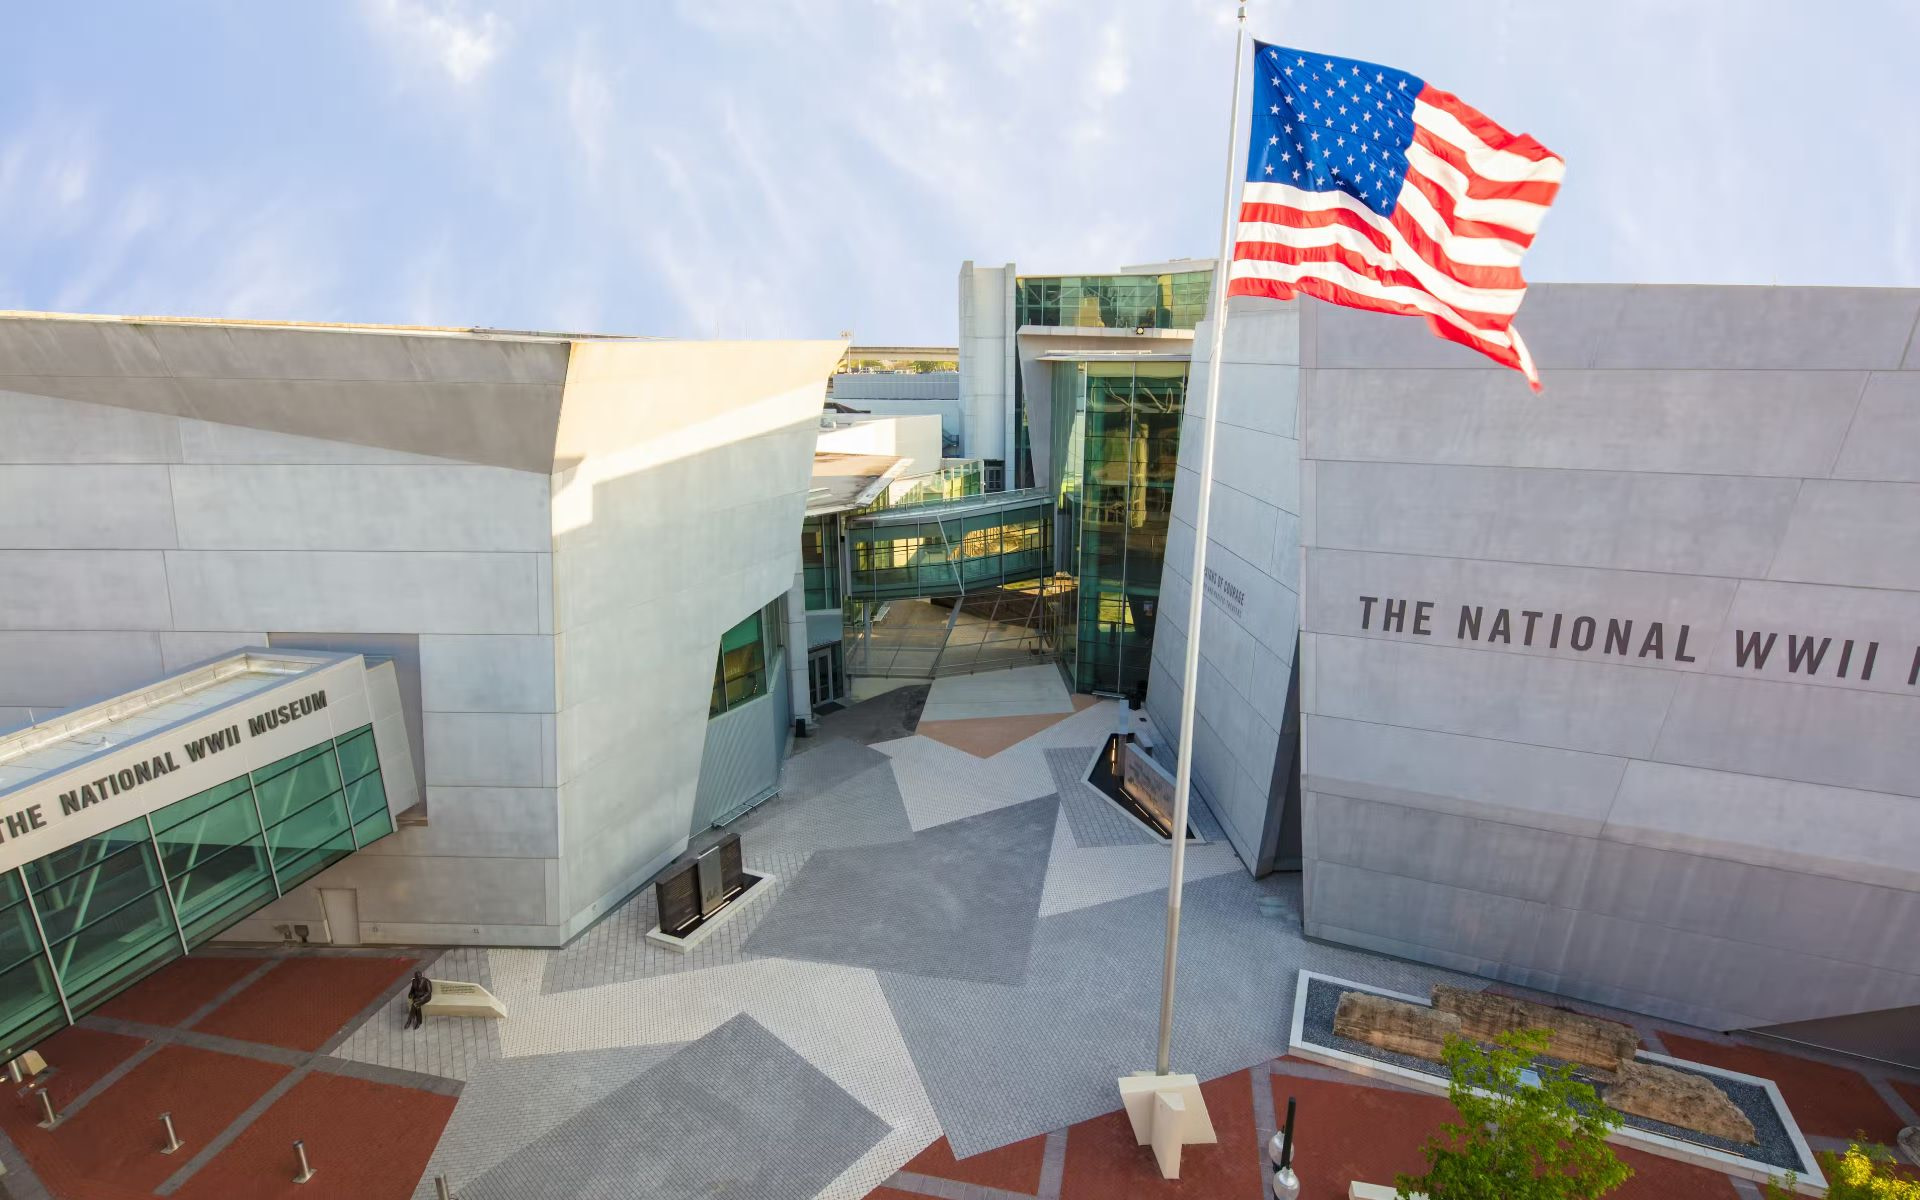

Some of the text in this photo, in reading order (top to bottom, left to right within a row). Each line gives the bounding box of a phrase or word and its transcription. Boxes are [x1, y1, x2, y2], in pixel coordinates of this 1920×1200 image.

[1359, 596, 1434, 636] THE
[1457, 605, 1696, 662] NATIONAL
[1735, 629, 1880, 681] WWII
[59, 752, 180, 816] NATIONAL
[184, 725, 241, 762] WWII
[248, 690, 328, 737] MUSEUM
